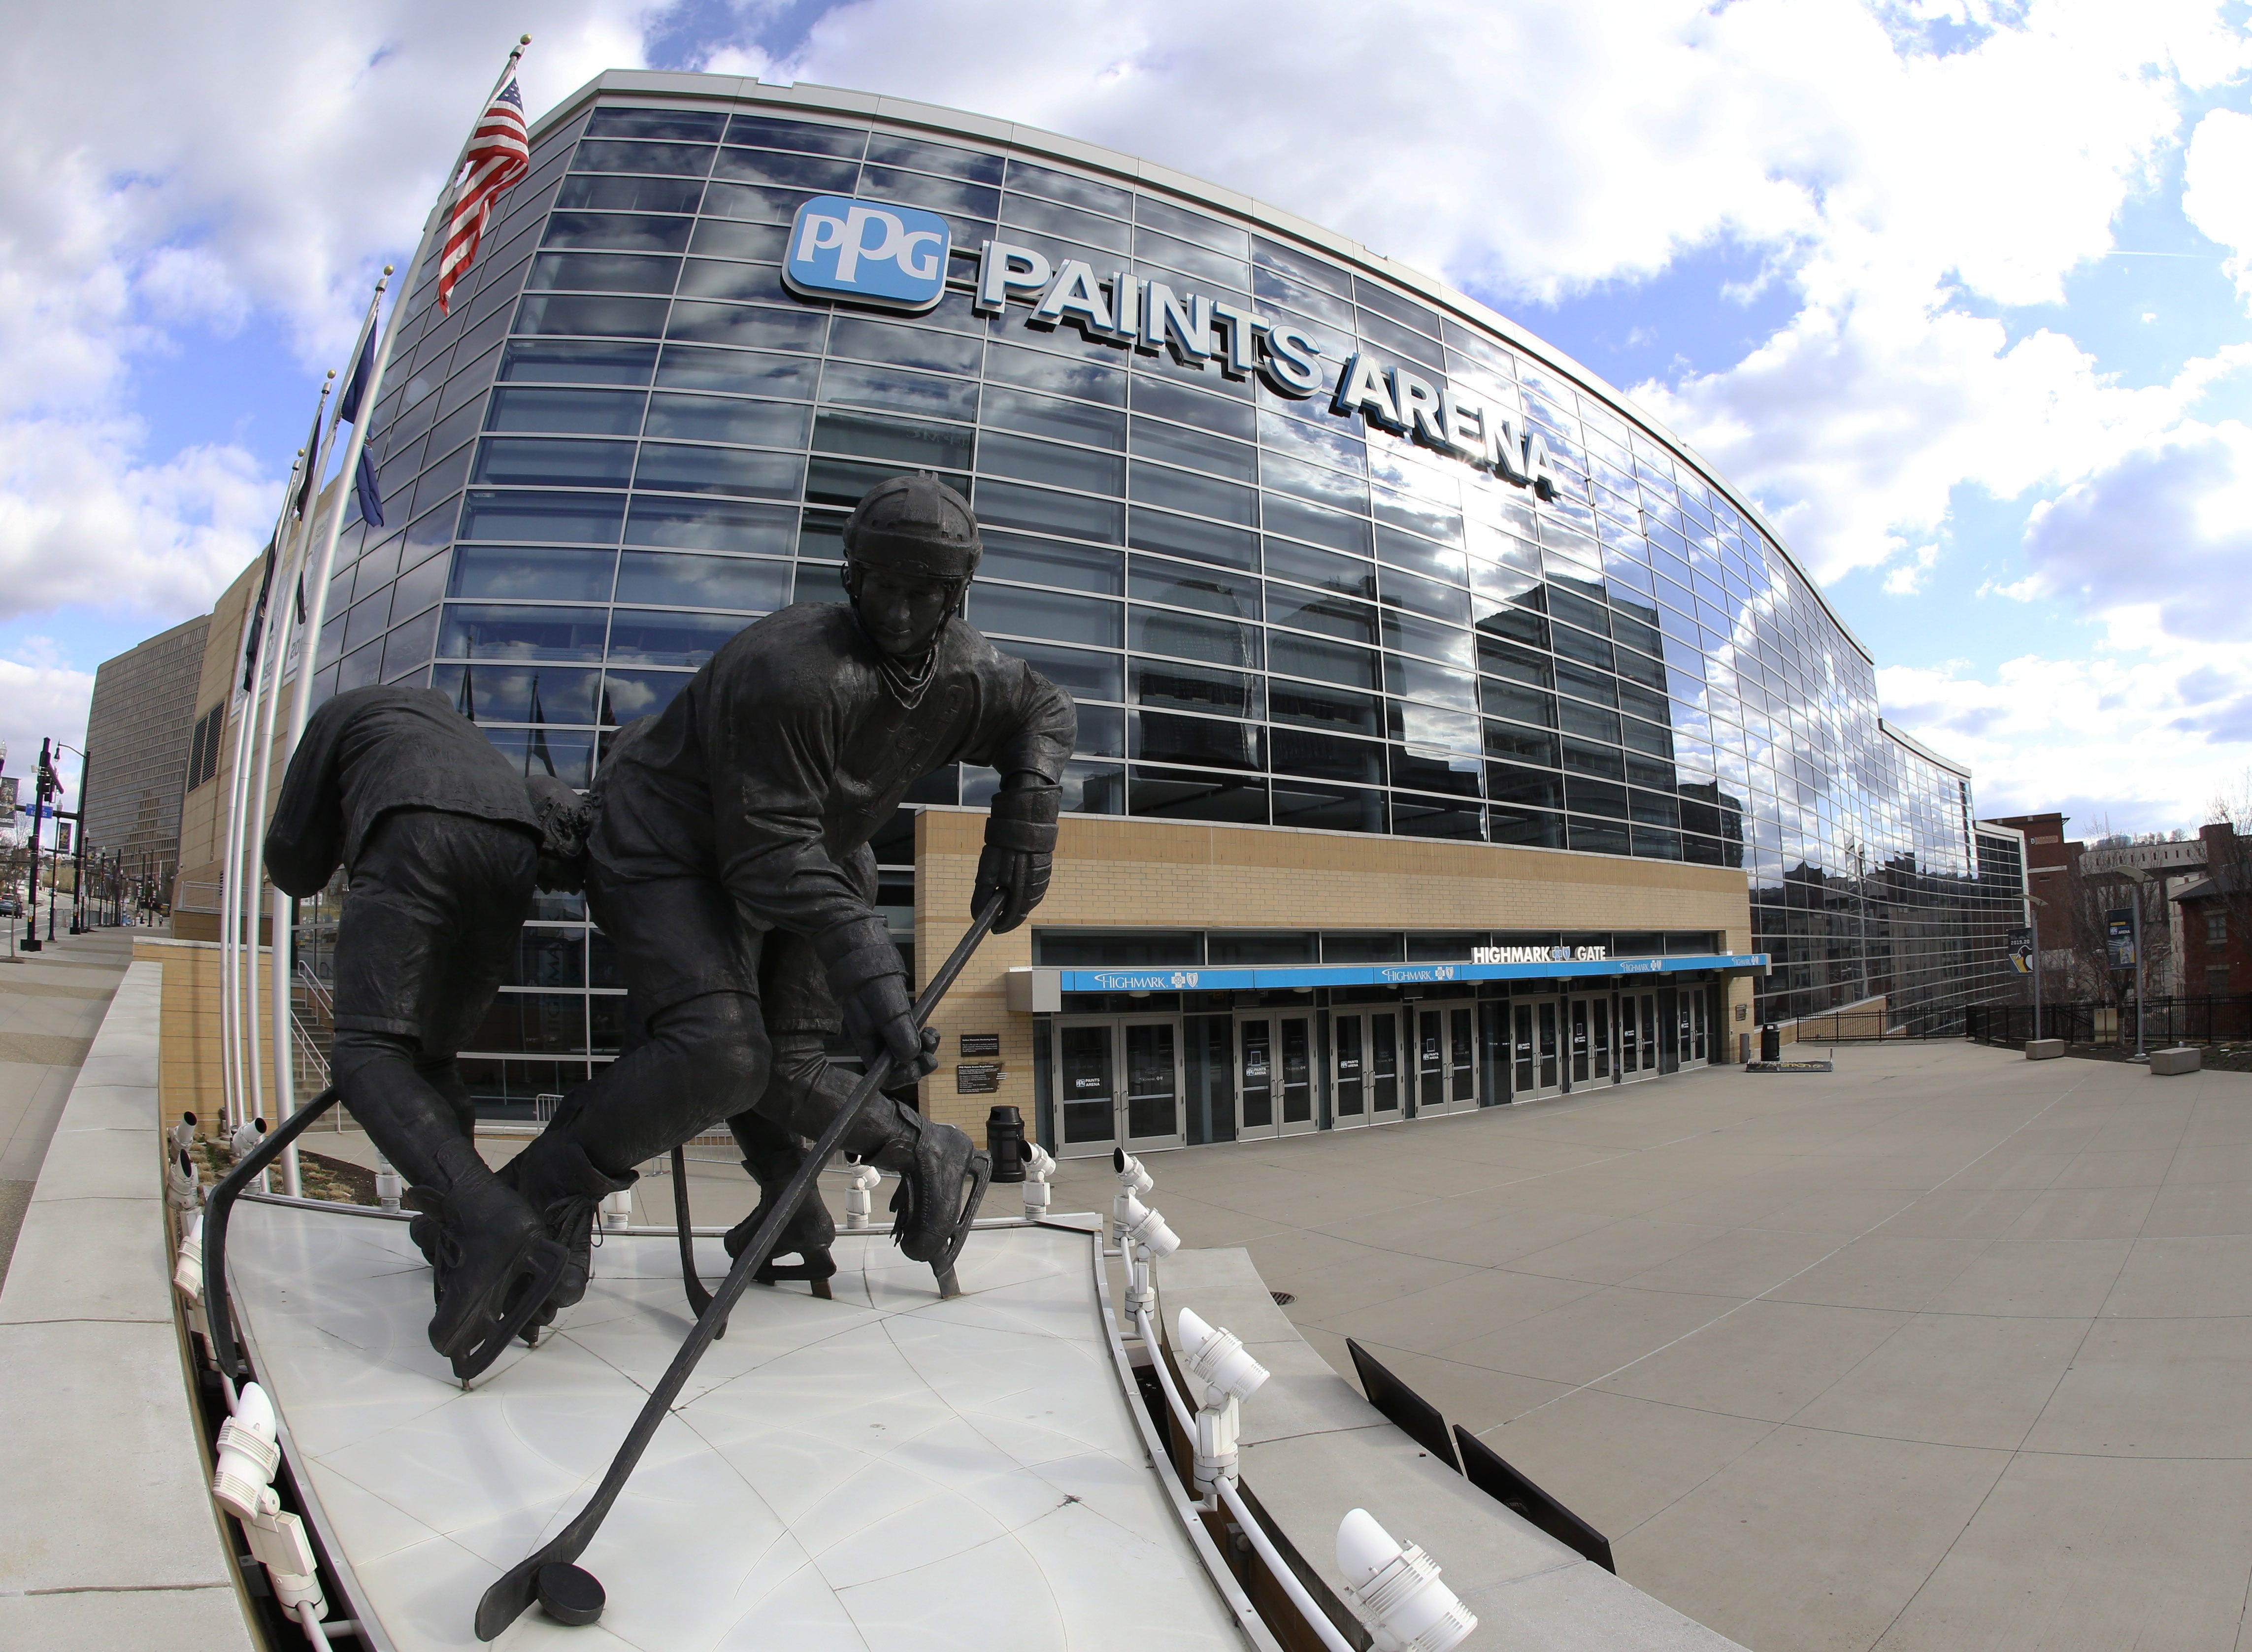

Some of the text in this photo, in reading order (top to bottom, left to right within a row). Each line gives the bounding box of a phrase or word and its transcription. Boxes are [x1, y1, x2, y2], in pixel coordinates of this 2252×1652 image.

[796, 206, 942, 283] PPG
[980, 239, 1562, 495] PAINTS ARENA
[1472, 946, 1606, 963] HIGHMARK GATE
[1382, 967, 1432, 982] HIGHMARK
[1620, 961, 1649, 972] HIGHMARK
[1094, 973, 1166, 989] HIGHMARK
